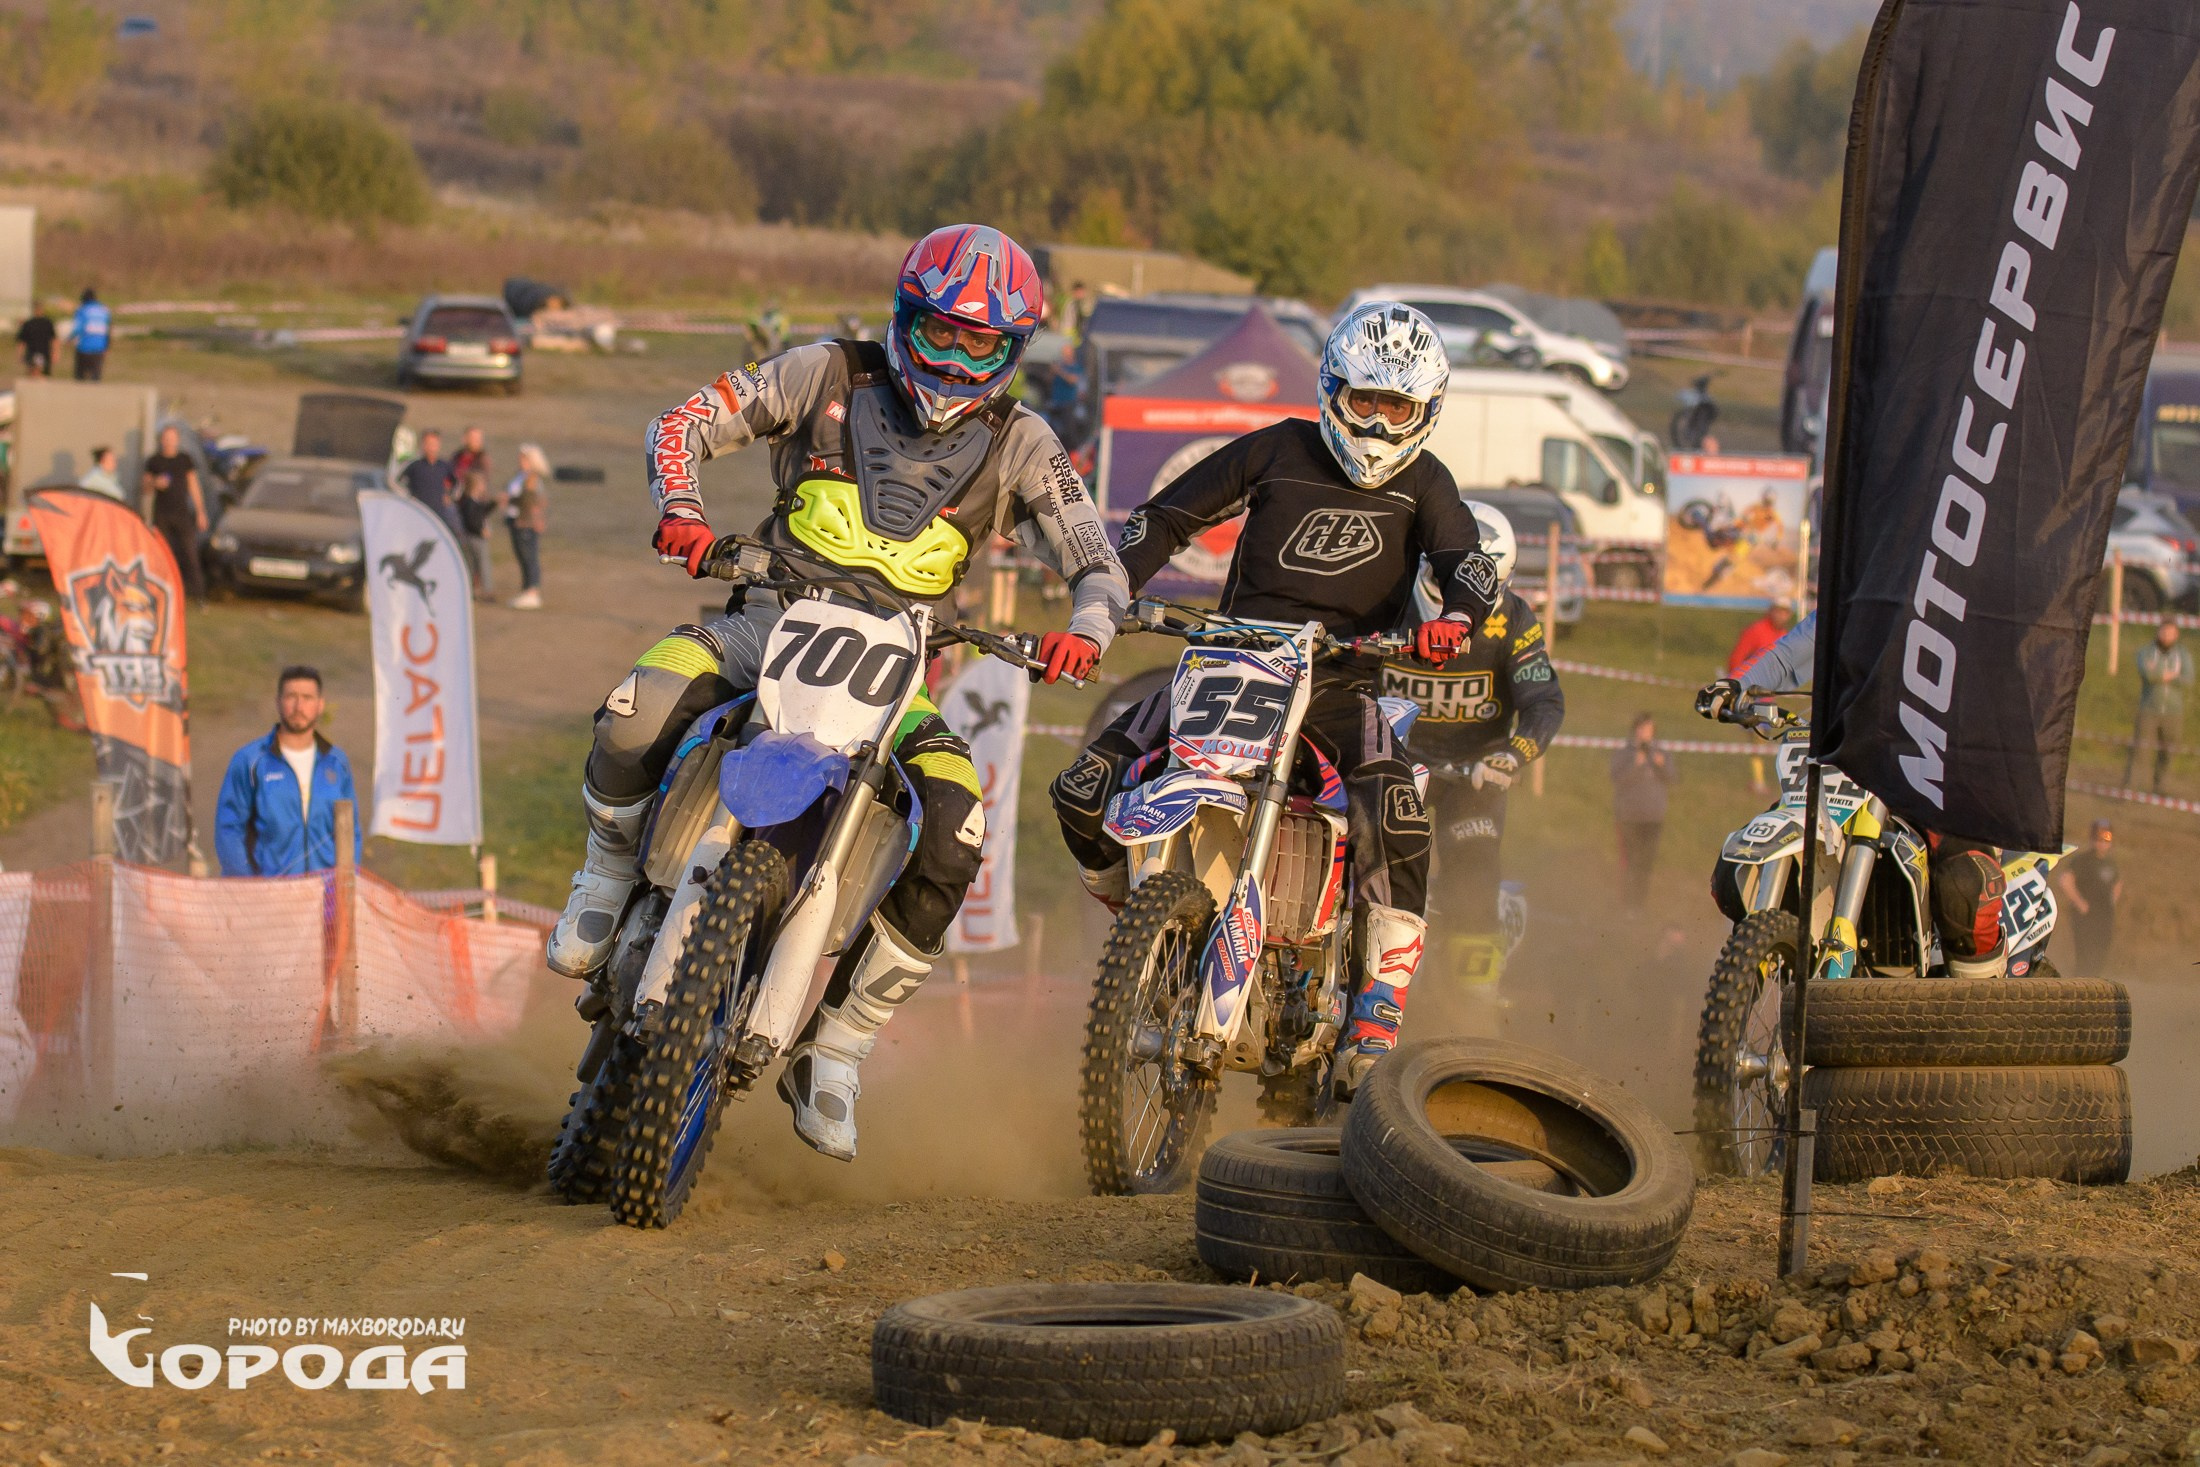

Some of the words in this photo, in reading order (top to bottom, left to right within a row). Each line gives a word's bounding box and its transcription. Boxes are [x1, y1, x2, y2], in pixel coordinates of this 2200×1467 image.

[1381, 357, 1409, 369] SHOEI
[1898, 1, 2116, 811] МОТОСЕРВИС
[763, 619, 918, 707] 700
[1386, 672, 1486, 700] MOTO
[1176, 676, 1291, 741] 55
[1201, 739, 1268, 761] MOTUL
[1131, 804, 1167, 821] YAMAHA
[1216, 938, 1236, 981] BRAKING
[1227, 913, 1249, 963] YAMAHA
